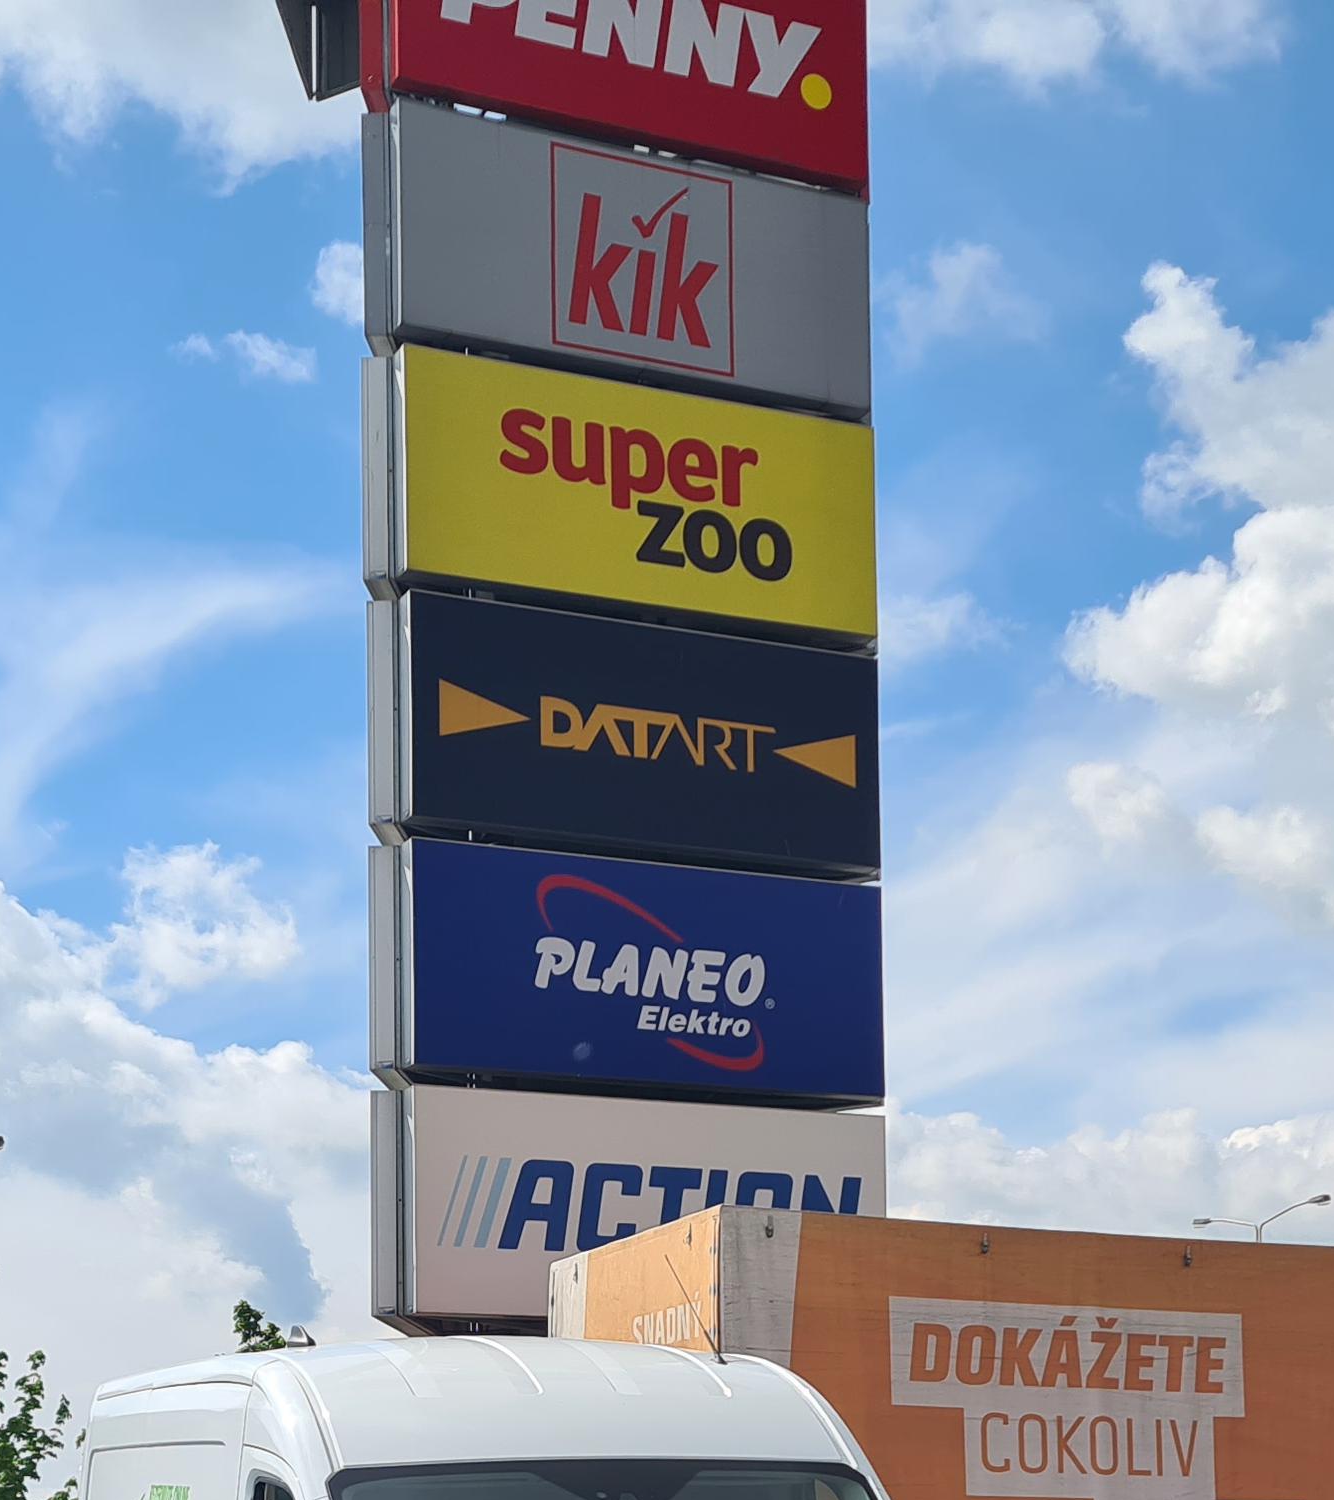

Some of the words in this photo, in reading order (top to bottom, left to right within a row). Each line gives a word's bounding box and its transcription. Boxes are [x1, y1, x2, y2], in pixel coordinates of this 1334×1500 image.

[499, 408, 759, 509] super
[635, 500, 793, 581] zoo
[539, 695, 777, 773] DATART
[534, 936, 766, 1007] PLANEO
[637, 1005, 752, 1038] Elektro
[632, 1290, 702, 1345] SNADNÝ
[908, 1315, 1227, 1394] DOKÁŽETE
[980, 1412, 1198, 1477] COKOLIV
